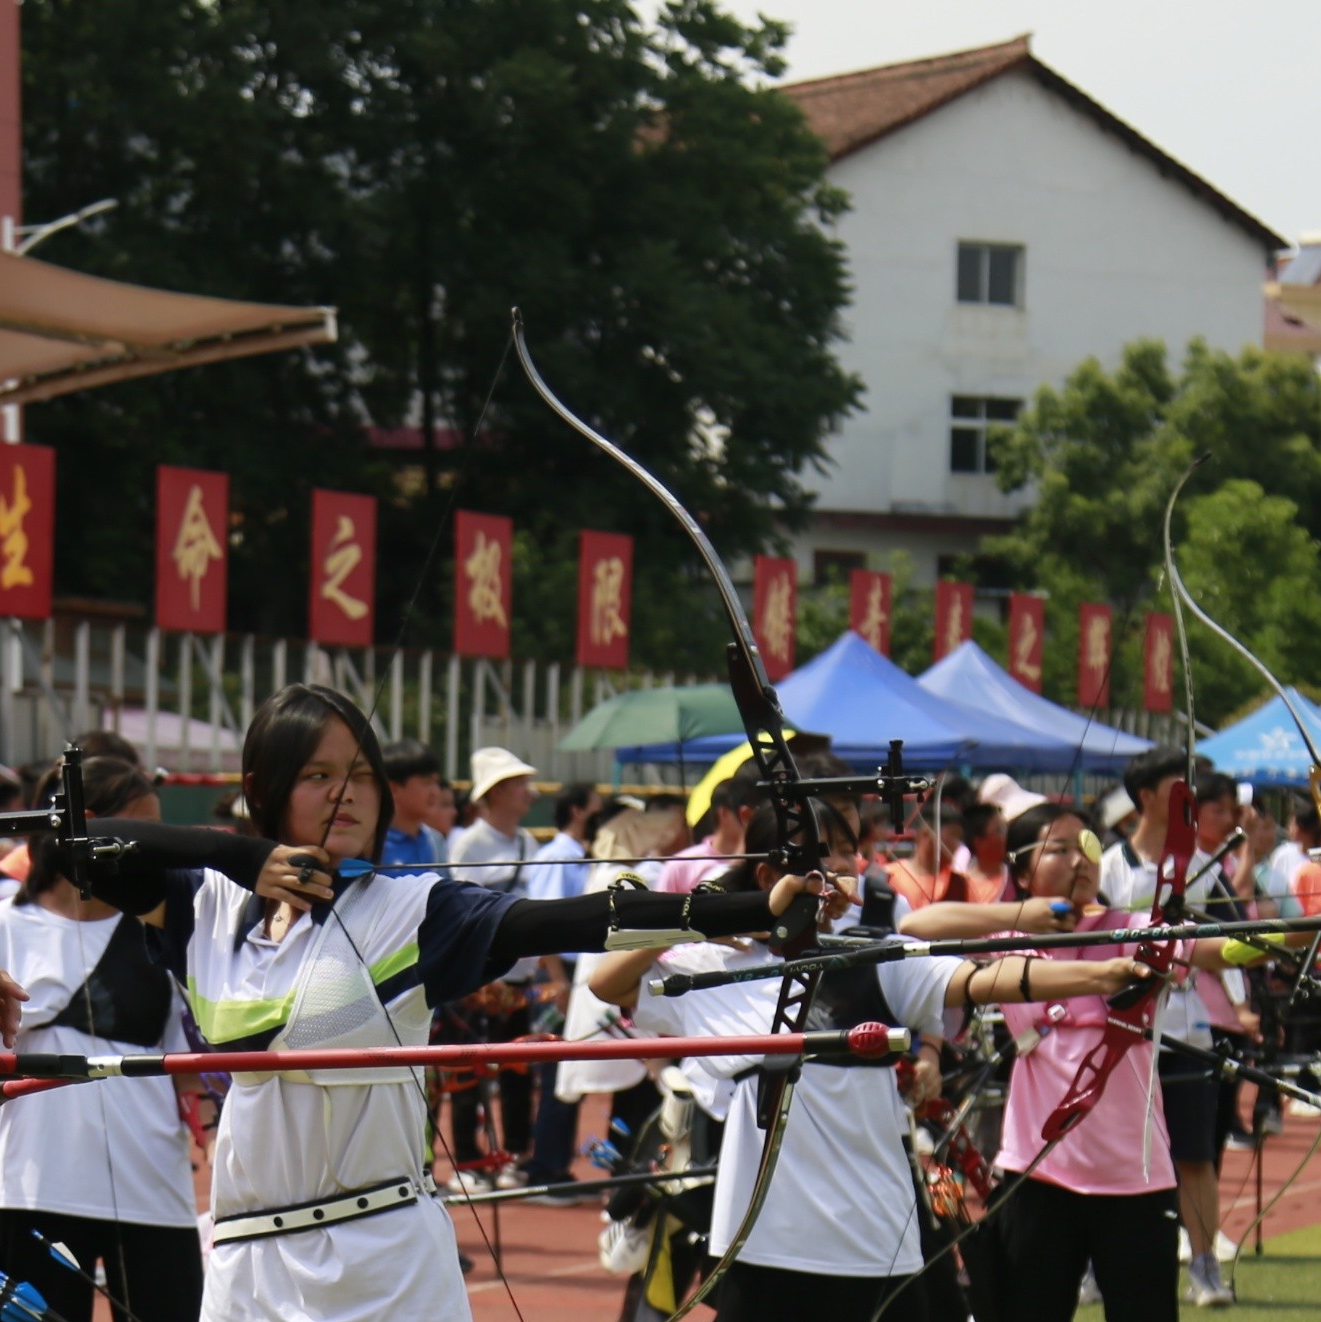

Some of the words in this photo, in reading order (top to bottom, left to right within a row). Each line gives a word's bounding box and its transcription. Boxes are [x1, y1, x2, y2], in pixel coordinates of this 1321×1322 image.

[172, 483, 224, 613] 命
[321, 514, 369, 621] 之
[464, 530, 508, 629] 极
[589, 556, 628, 647] 限
